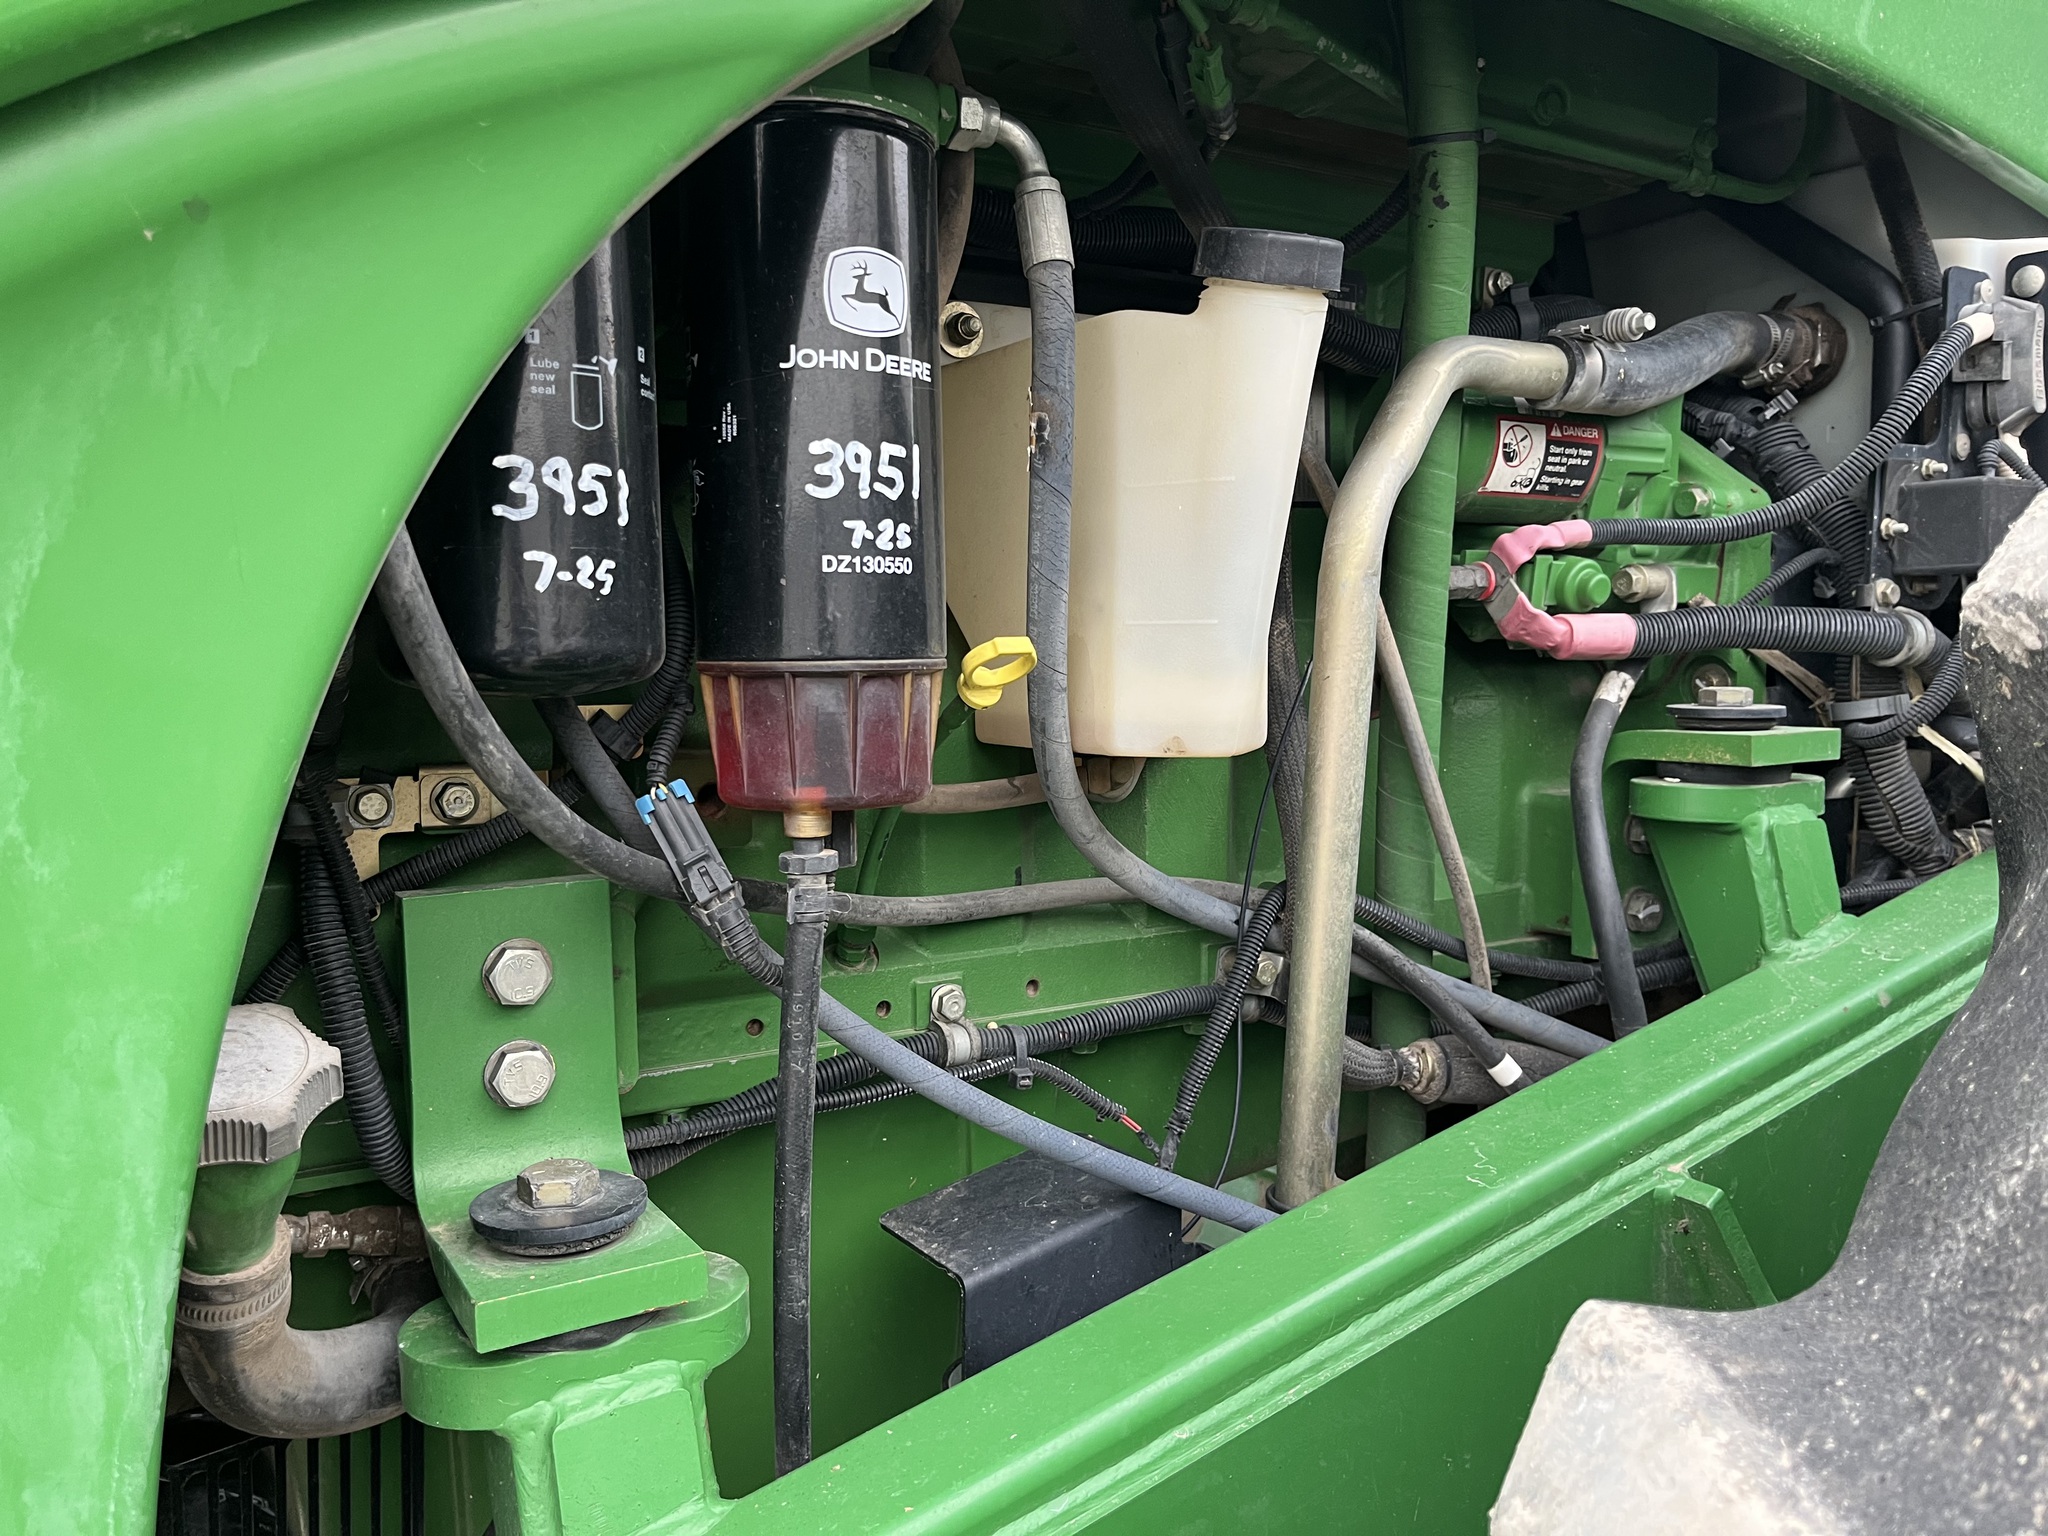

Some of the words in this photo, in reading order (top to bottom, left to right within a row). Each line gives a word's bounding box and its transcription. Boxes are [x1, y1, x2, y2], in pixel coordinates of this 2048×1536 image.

[529, 357, 560, 369] Lube
[779, 344, 860, 371] JOHN
[865, 347, 932, 383] DEERE
[529, 372, 556, 382] new
[530, 384, 556, 395] seal
[1562, 425, 1599, 439] DANGER
[1549, 444, 1564, 454] Start
[1565, 447, 1578, 457] only
[1578, 448, 1593, 457] from
[1547, 455, 1561, 463] seat
[1567, 458, 1582, 466] park
[804, 437, 920, 502] 3951
[1544, 464, 1567, 473] neutral.
[1539, 475, 1564, 486] Starting
[1564, 477, 1570, 485] in
[1570, 479, 1585, 487] gear
[491, 454, 630, 527] 3951
[821, 554, 913, 575] DZ130550
[522, 550, 617, 596] 7-25
[505, 956, 535, 972] TVS
